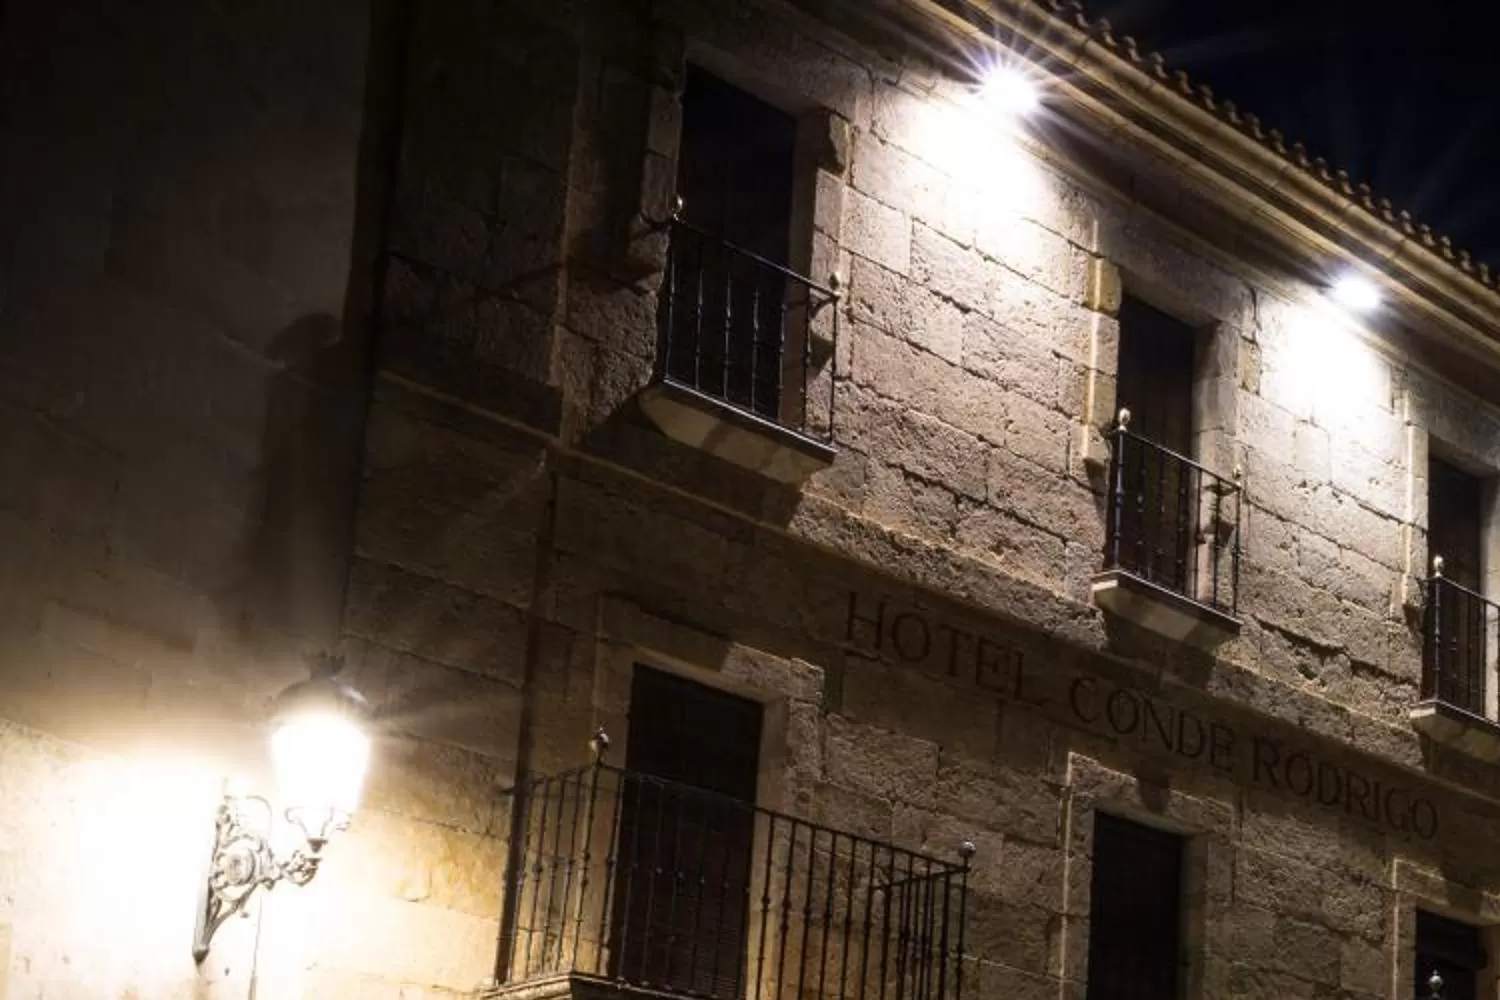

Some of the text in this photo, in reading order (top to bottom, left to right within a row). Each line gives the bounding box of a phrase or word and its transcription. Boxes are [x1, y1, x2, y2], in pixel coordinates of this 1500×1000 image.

[845, 590, 1438, 841] HOTEL CONDE RODRIGO
